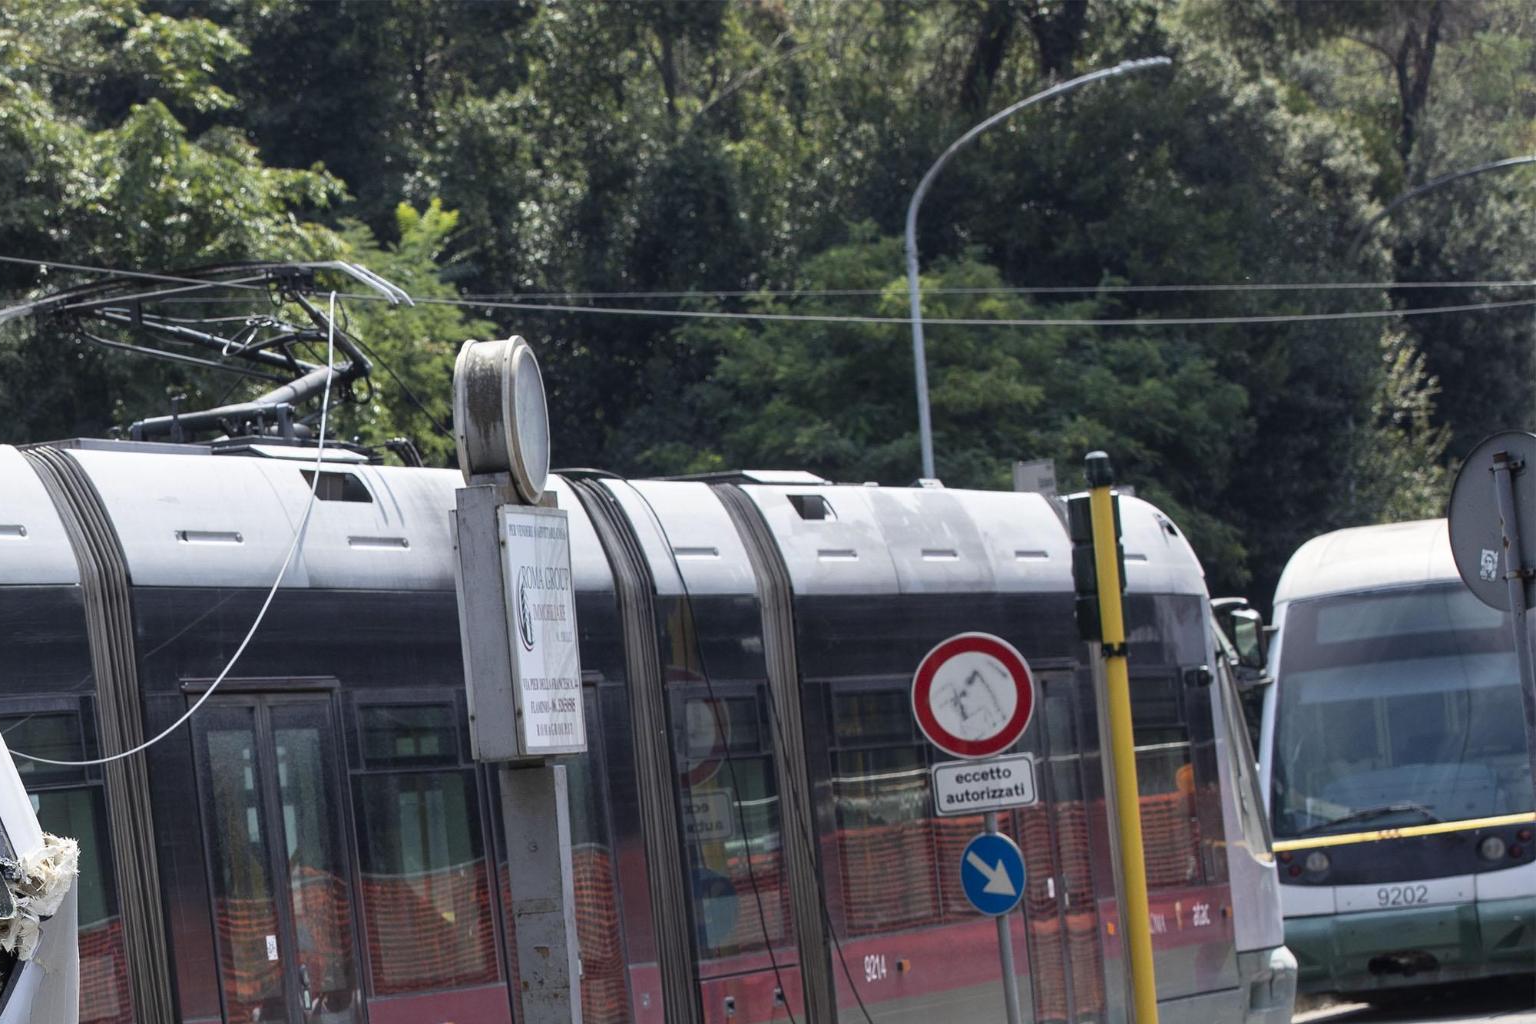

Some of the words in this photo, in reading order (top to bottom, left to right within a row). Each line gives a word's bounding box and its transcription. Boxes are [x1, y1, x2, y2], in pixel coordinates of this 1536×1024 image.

[955, 767, 1012, 784] eccetto
[946, 783, 1025, 804] autorizzati
[1377, 884, 1428, 906] 9202
[864, 954, 887, 982] 9214
